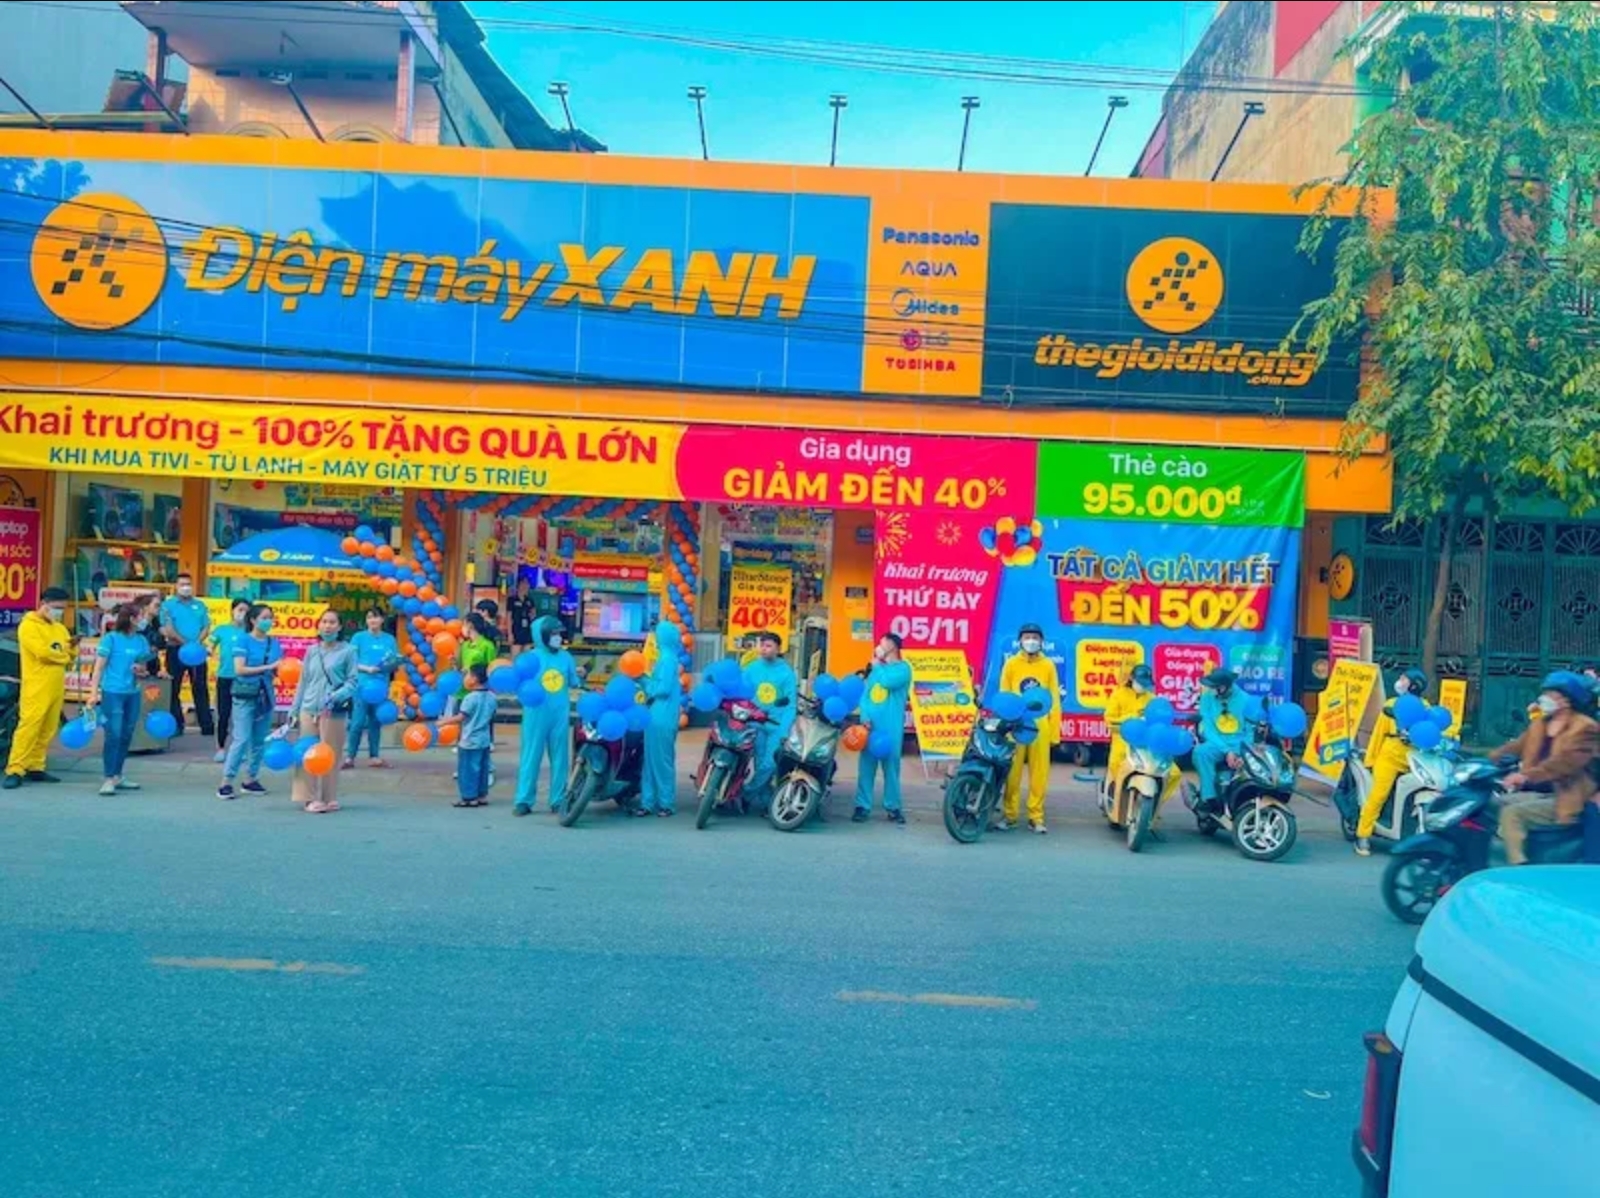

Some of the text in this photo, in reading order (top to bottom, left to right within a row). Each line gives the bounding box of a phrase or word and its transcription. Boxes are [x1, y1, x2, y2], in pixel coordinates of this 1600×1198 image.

[883, 226, 980, 246] Panasonic
[182, 225, 817, 322] Điện máy XANH
[900, 260, 958, 277] AQUA
[1034, 334, 1318, 386] thegioididong
[0, 403, 73, 436] Khai
[82, 408, 220, 450] trương
[253, 416, 354, 449] 100%
[361, 414, 471, 459] TẶNG
[479, 423, 568, 460] QUÀ
[577, 426, 658, 464] LỚN
[50, 447, 87, 465] KHI
[93, 448, 142, 468] MUA
[149, 451, 189, 470] TIVI
[208, 451, 237, 473] TỦ
[243, 456, 303, 477] LẠNH
[323, 457, 369, 478] MÁY
[375, 459, 424, 484] GIẶT
[429, 460, 460, 483] TỪ
[465, 466, 477, 484] 5
[483, 465, 547, 489] TRIỆU
[800, 437, 911, 468] Gia dụng
[1108, 453, 1208, 478] Thẻ cào
[723, 461, 1007, 510] GIẢM ĐẾN 40%
[1082, 482, 1243, 518] 95.000đ
[927, 564, 989, 588] trương
[1048, 548, 1281, 586] TẤT CẢ GIẢM HẾT
[883, 585, 935, 609] THỨ
[1070, 582, 1261, 632] ĐẾN 50%
[732, 606, 787, 630] 40%
[890, 614, 969, 646] 05/11
